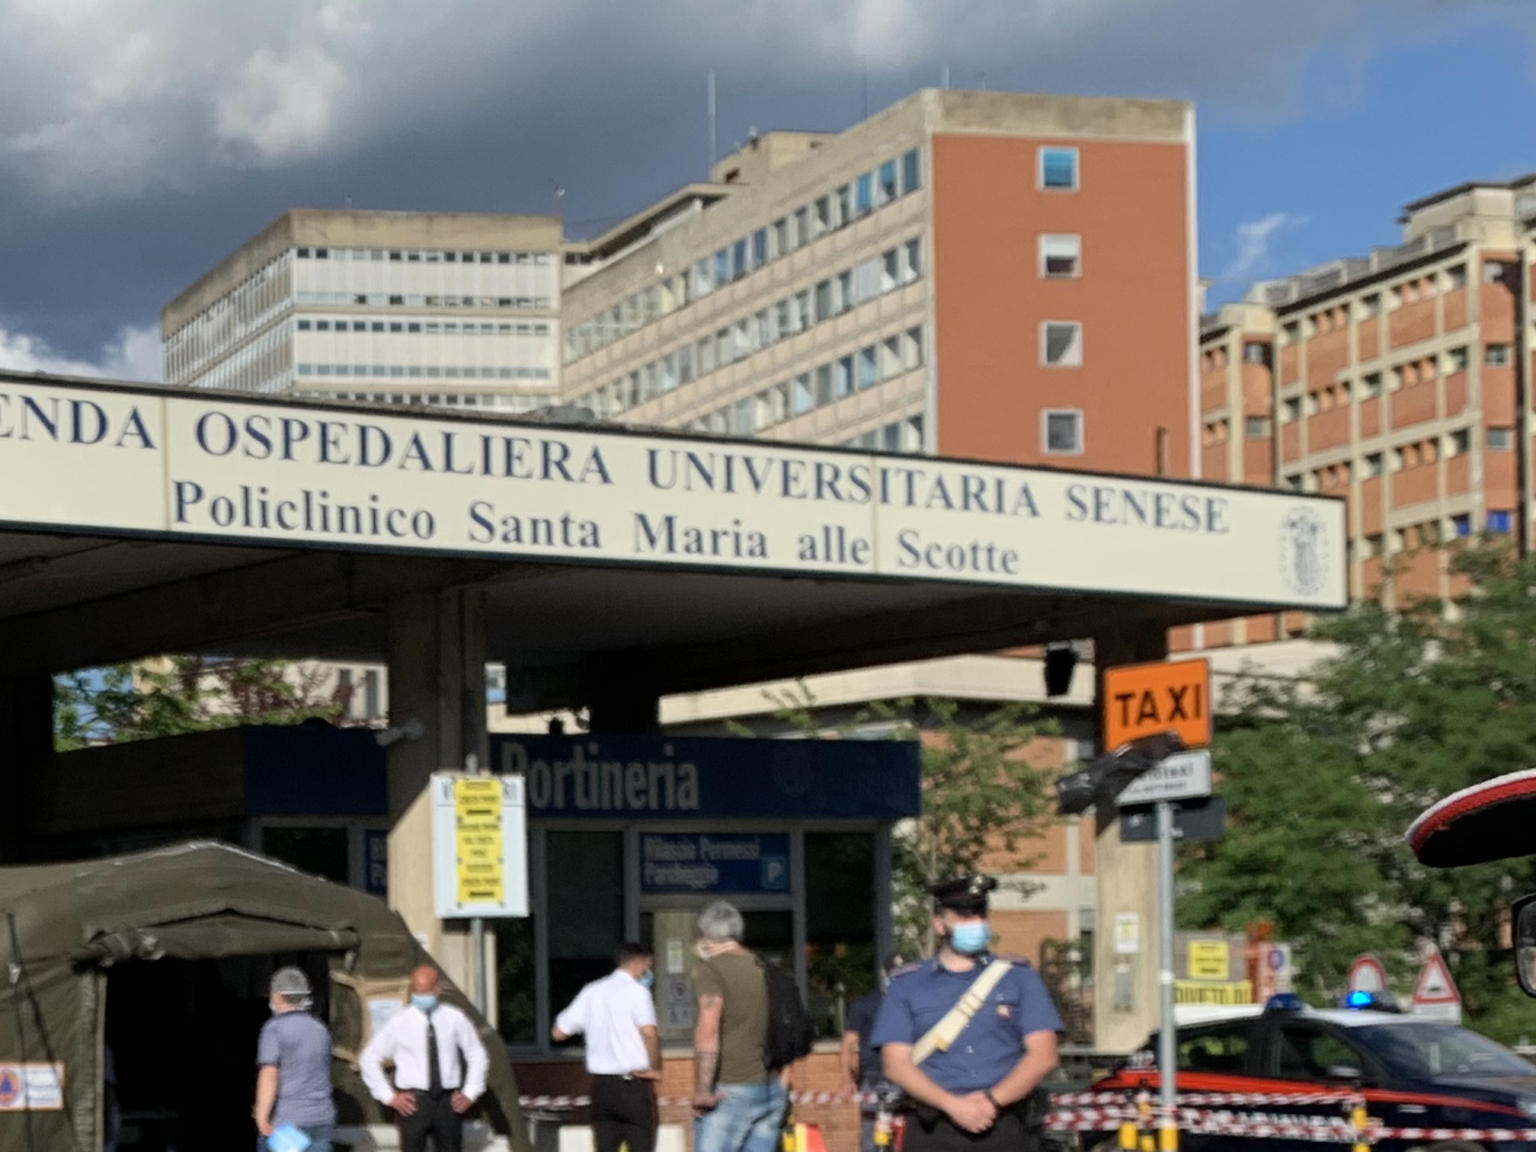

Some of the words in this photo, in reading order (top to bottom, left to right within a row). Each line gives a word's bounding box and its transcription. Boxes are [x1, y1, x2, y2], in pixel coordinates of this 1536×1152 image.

[194, 411, 614, 487] OSPEDALIERA
[647, 448, 1040, 518] UNIVERSITARIA
[1066, 484, 1230, 535] SENESE
[172, 480, 436, 541] Policlinico
[469, 500, 601, 550] Santa
[633, 512, 769, 560] Maria
[797, 525, 871, 566] alle
[897, 530, 1021, 577] Scotte
[1113, 683, 1202, 729] TAXI
[500, 741, 700, 811] Portineria
